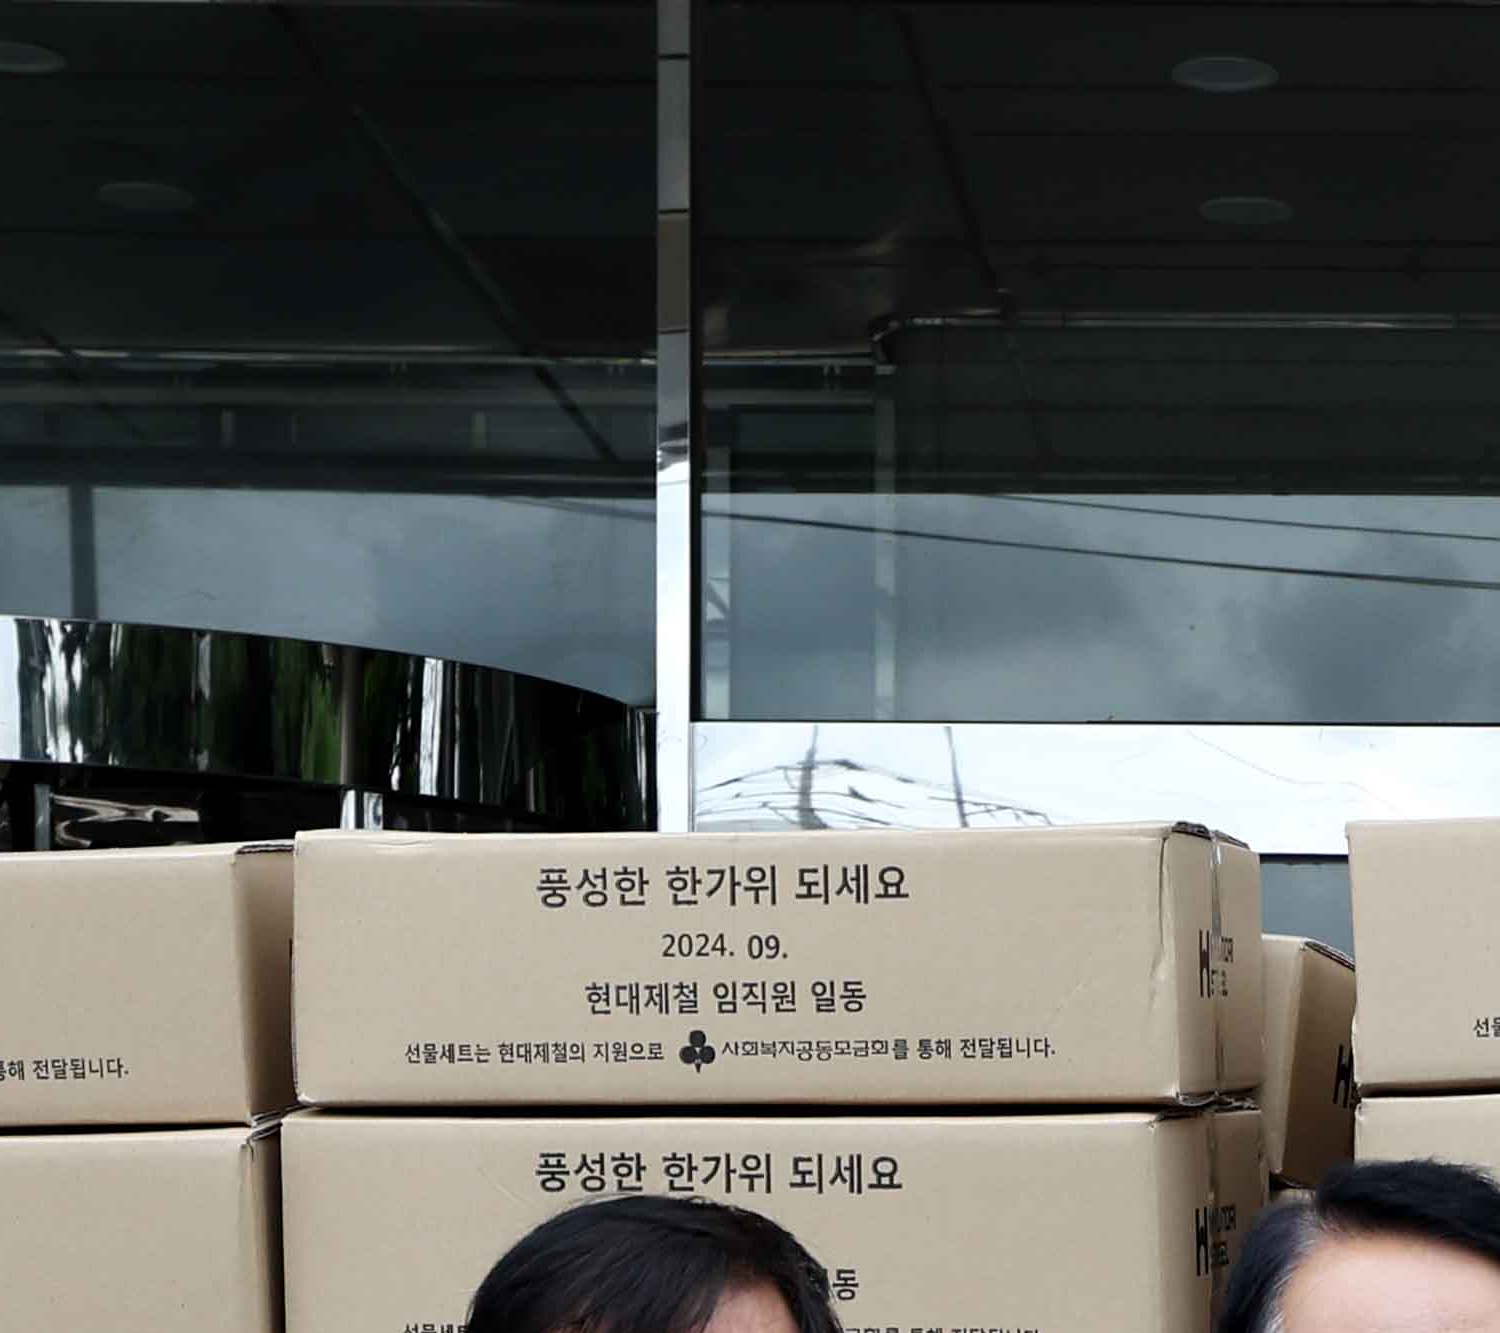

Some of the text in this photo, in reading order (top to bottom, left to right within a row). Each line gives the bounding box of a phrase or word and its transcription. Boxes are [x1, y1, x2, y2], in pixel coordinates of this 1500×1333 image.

[535, 863, 910, 909] 풍성한 한가위 되세요
[661, 932, 789, 960] 2024. 09.
[584, 979, 867, 1017] 현대제철 임직원 일동
[404, 1042, 492, 1065] 선물세트는
[497, 1041, 586, 1065] 현대제철의
[592, 1041, 665, 1064] 지원으로
[916, 1038, 952, 1060] 통해
[959, 1036, 1056, 1060] 전달됩니다.
[32, 1057, 129, 1081] 전달됩니다.
